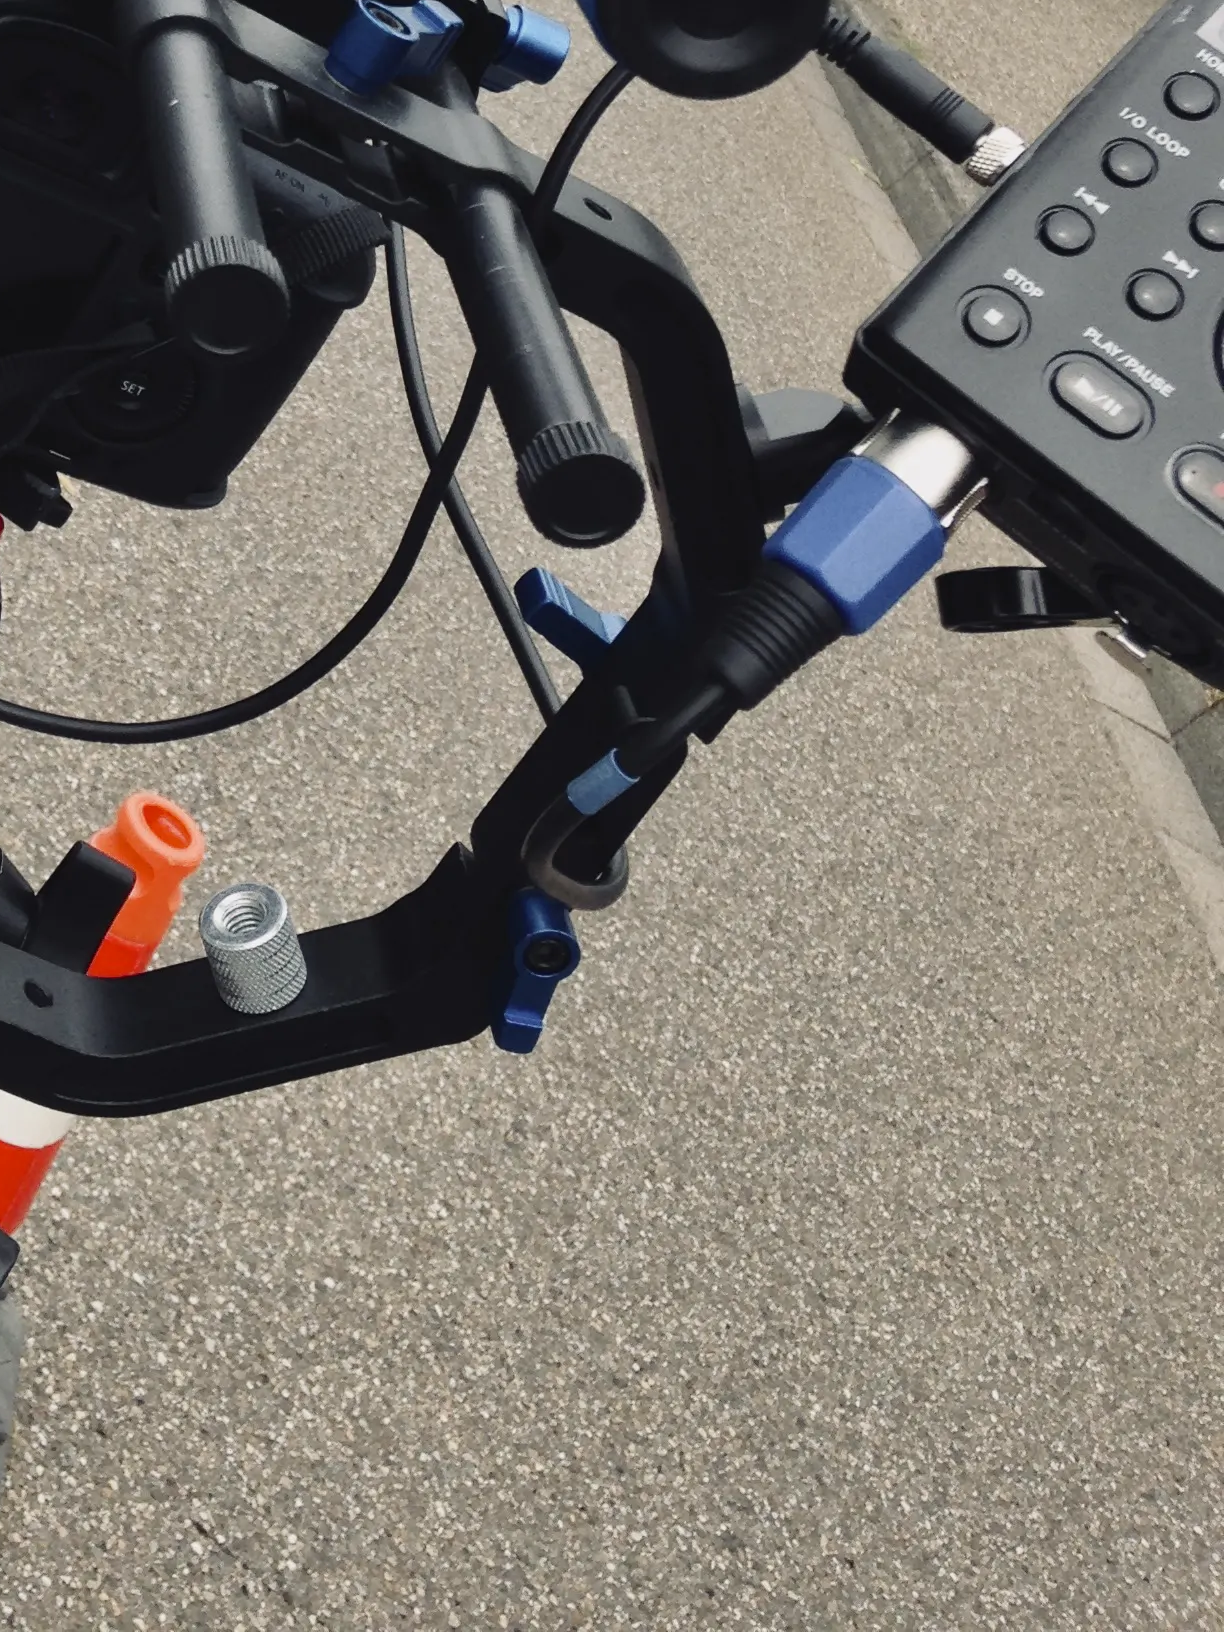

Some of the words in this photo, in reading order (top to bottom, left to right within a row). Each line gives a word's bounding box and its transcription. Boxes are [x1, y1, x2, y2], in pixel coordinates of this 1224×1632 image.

[1118, 107, 1147, 129] I/O
[1146, 126, 1191, 157] LOOP
[1002, 268, 1045, 298] STOP
[120, 380, 146, 396] SET
